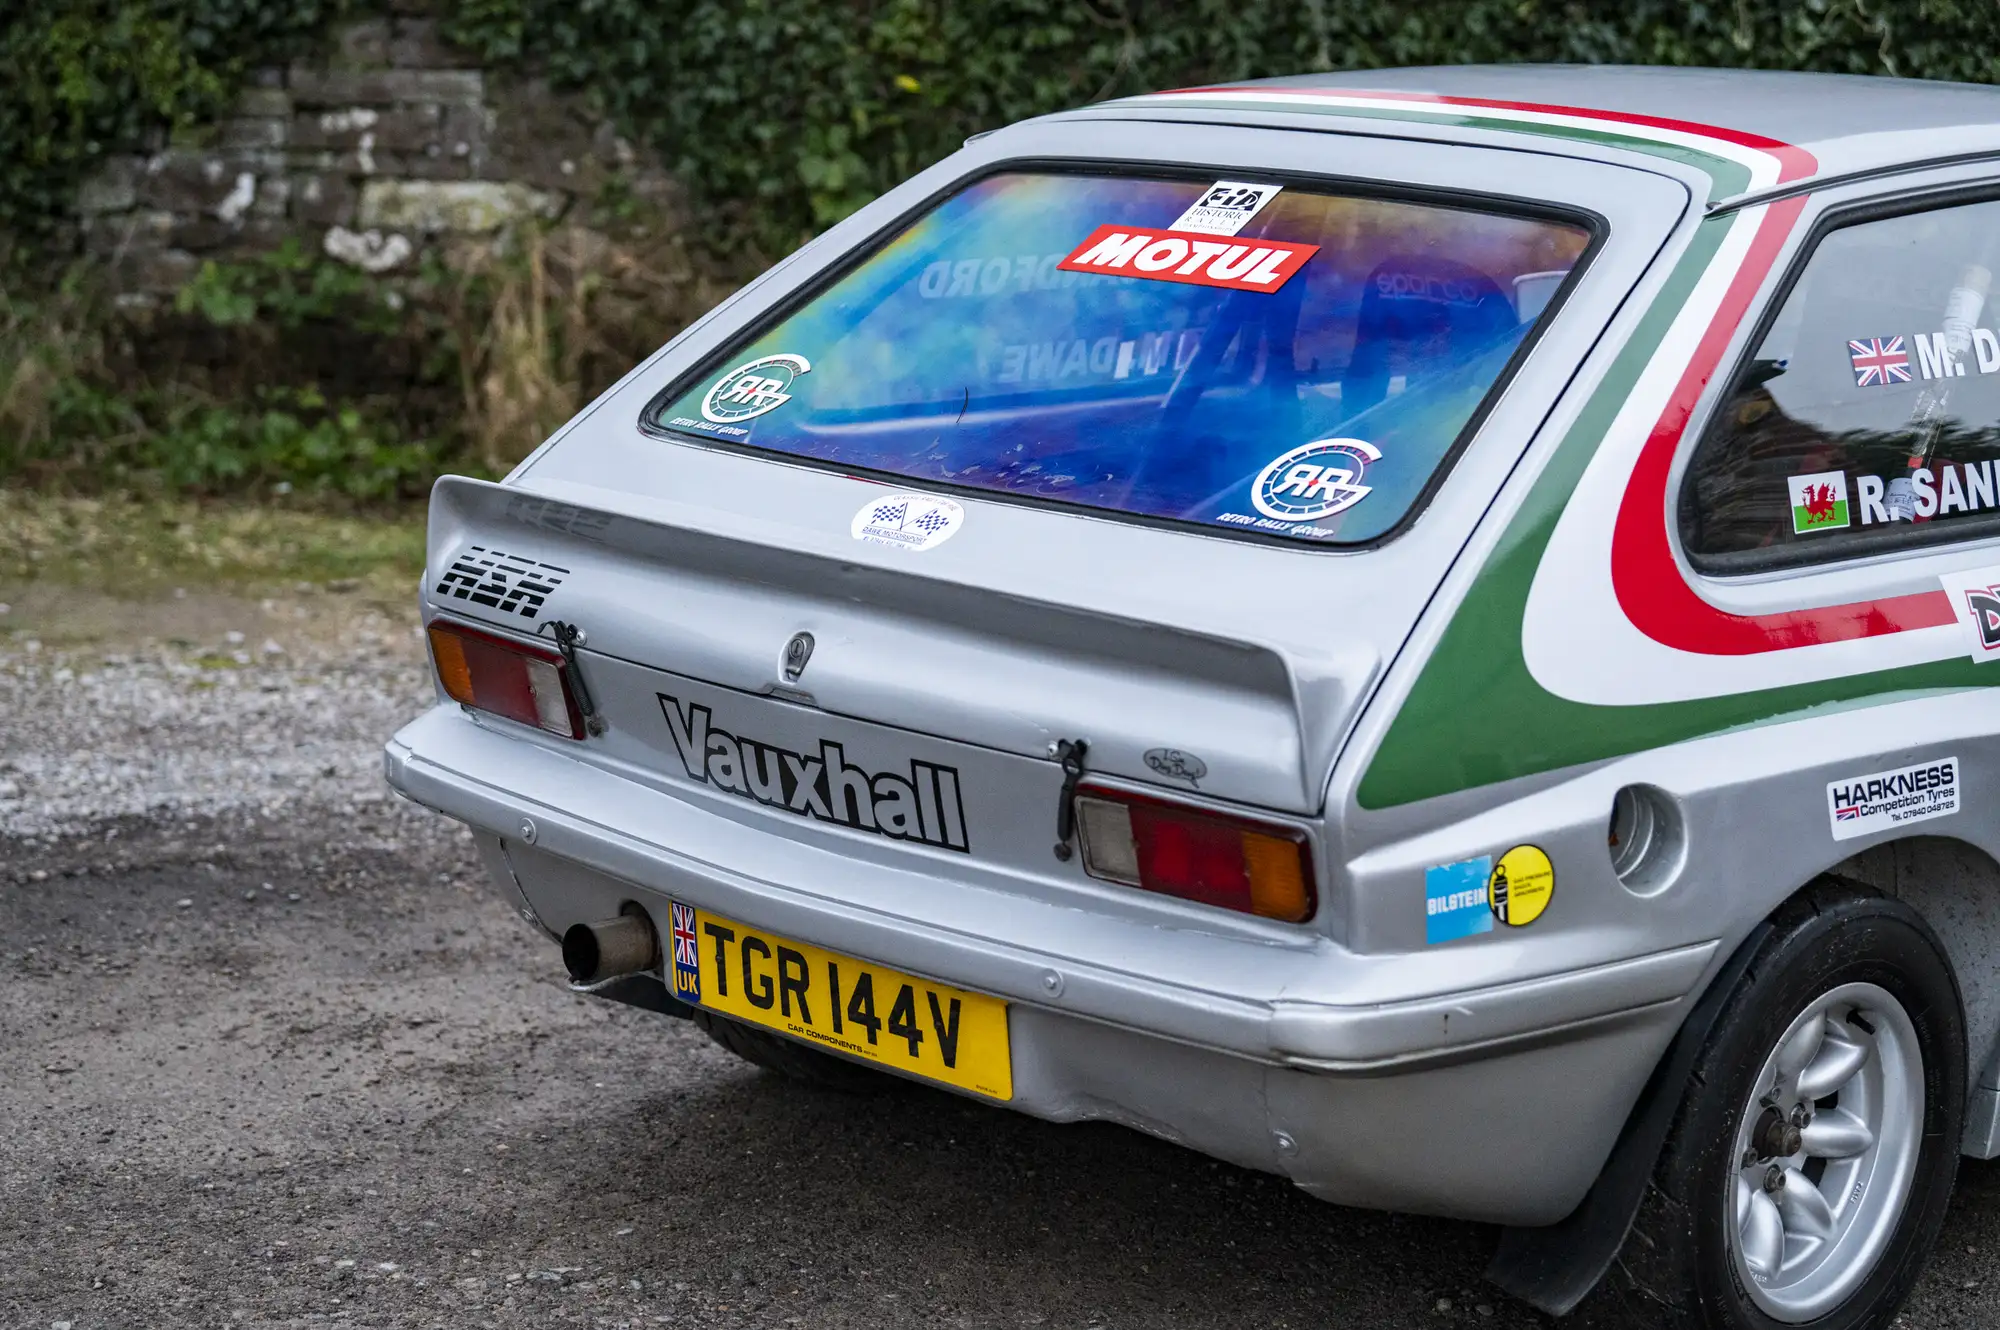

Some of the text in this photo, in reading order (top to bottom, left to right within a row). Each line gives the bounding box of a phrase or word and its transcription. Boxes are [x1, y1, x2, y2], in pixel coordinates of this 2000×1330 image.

[1191, 208, 1244, 219] HISTORIC
[1072, 232, 1294, 285] MOTUL
[1914, 328, 2000, 380] M. D
[696, 420, 724, 431] RALLY
[1856, 475, 1901, 525] R.
[1912, 459, 2000, 517] SAN
[1216, 512, 1334, 539] RETRO RALLY GROUP
[656, 692, 970, 854] Vauxhall
[1833, 763, 1955, 808] HARKNESS
[1860, 787, 1955, 817] Competition Tyres
[1427, 887, 1488, 916] BILSTEIN
[678, 969, 698, 995] UK
[704, 921, 961, 1069] TGR 144V
[788, 1023, 804, 1034] CAR
[806, 1029, 863, 1053] COMPONENTS
